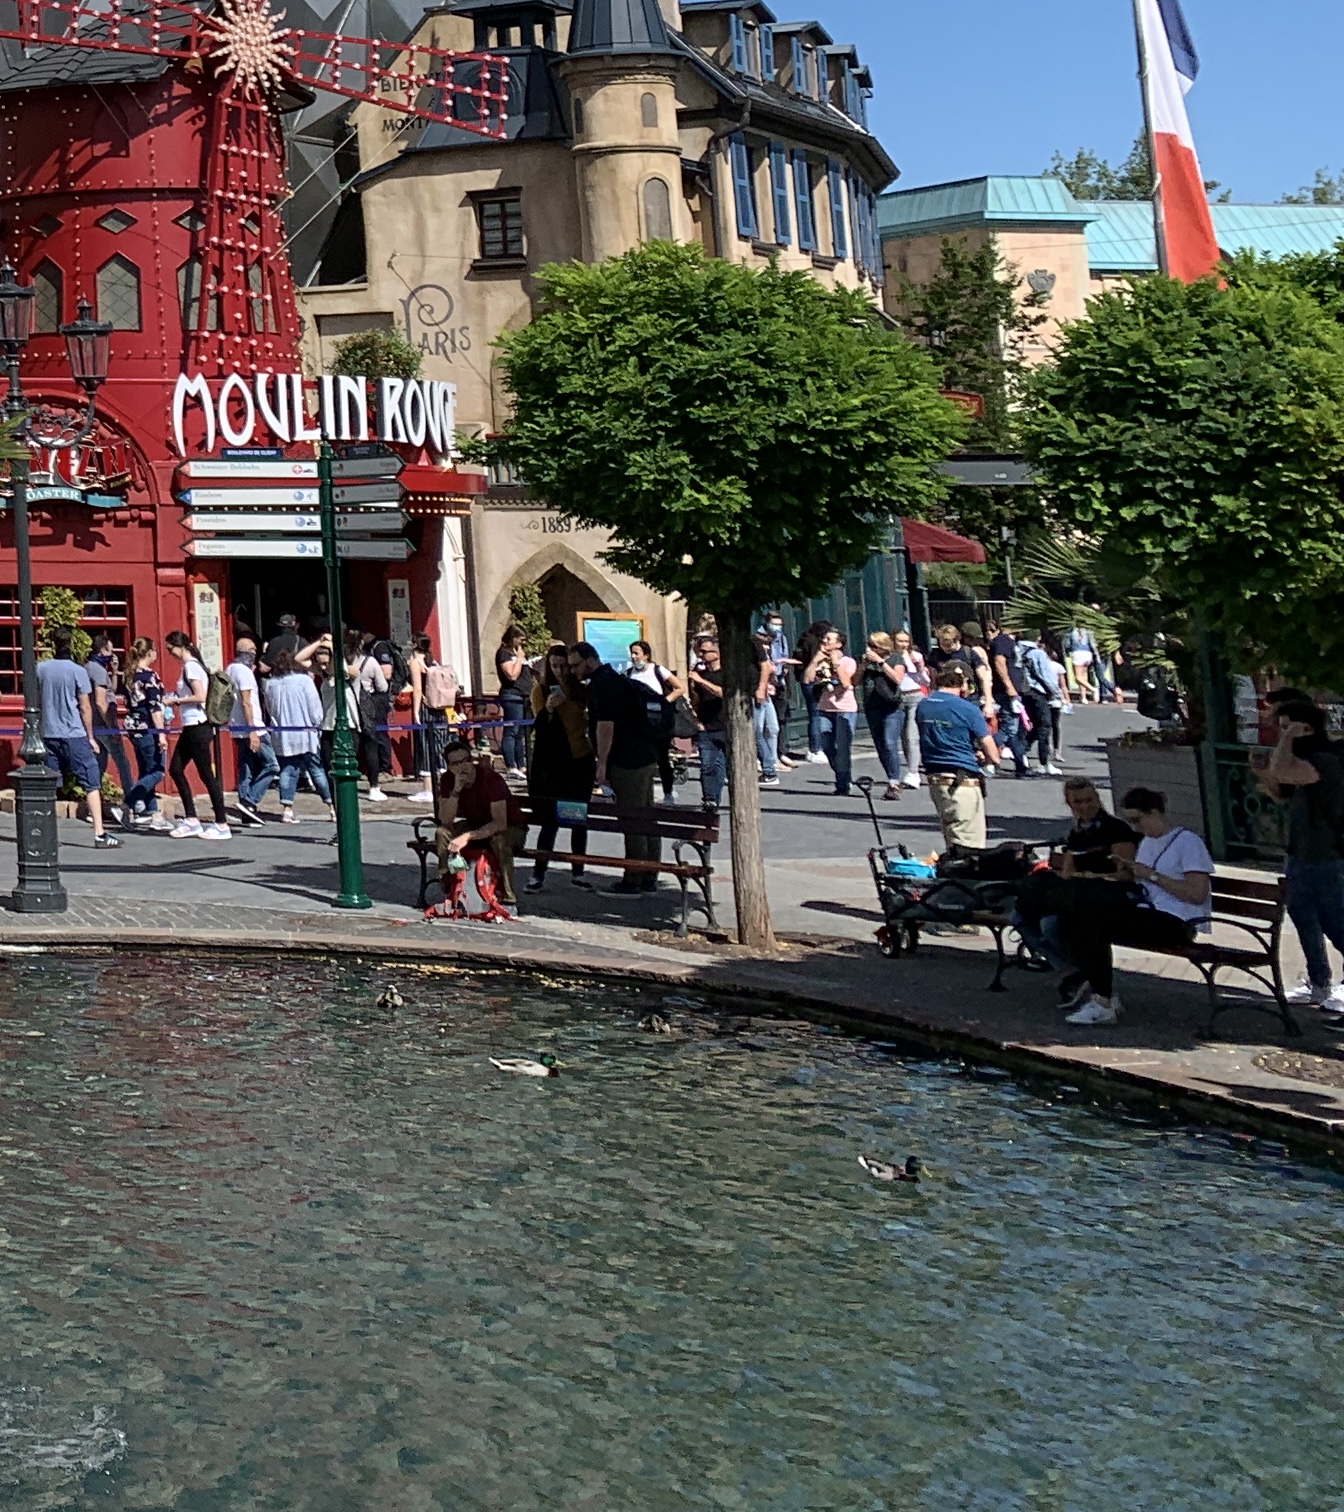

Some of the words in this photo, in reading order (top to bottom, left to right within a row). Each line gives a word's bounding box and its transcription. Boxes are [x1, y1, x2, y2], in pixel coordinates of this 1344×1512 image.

[172, 372, 369, 458] MOULIN
[26, 489, 79, 500] OASTER
[541, 516, 572, 533] 1889
